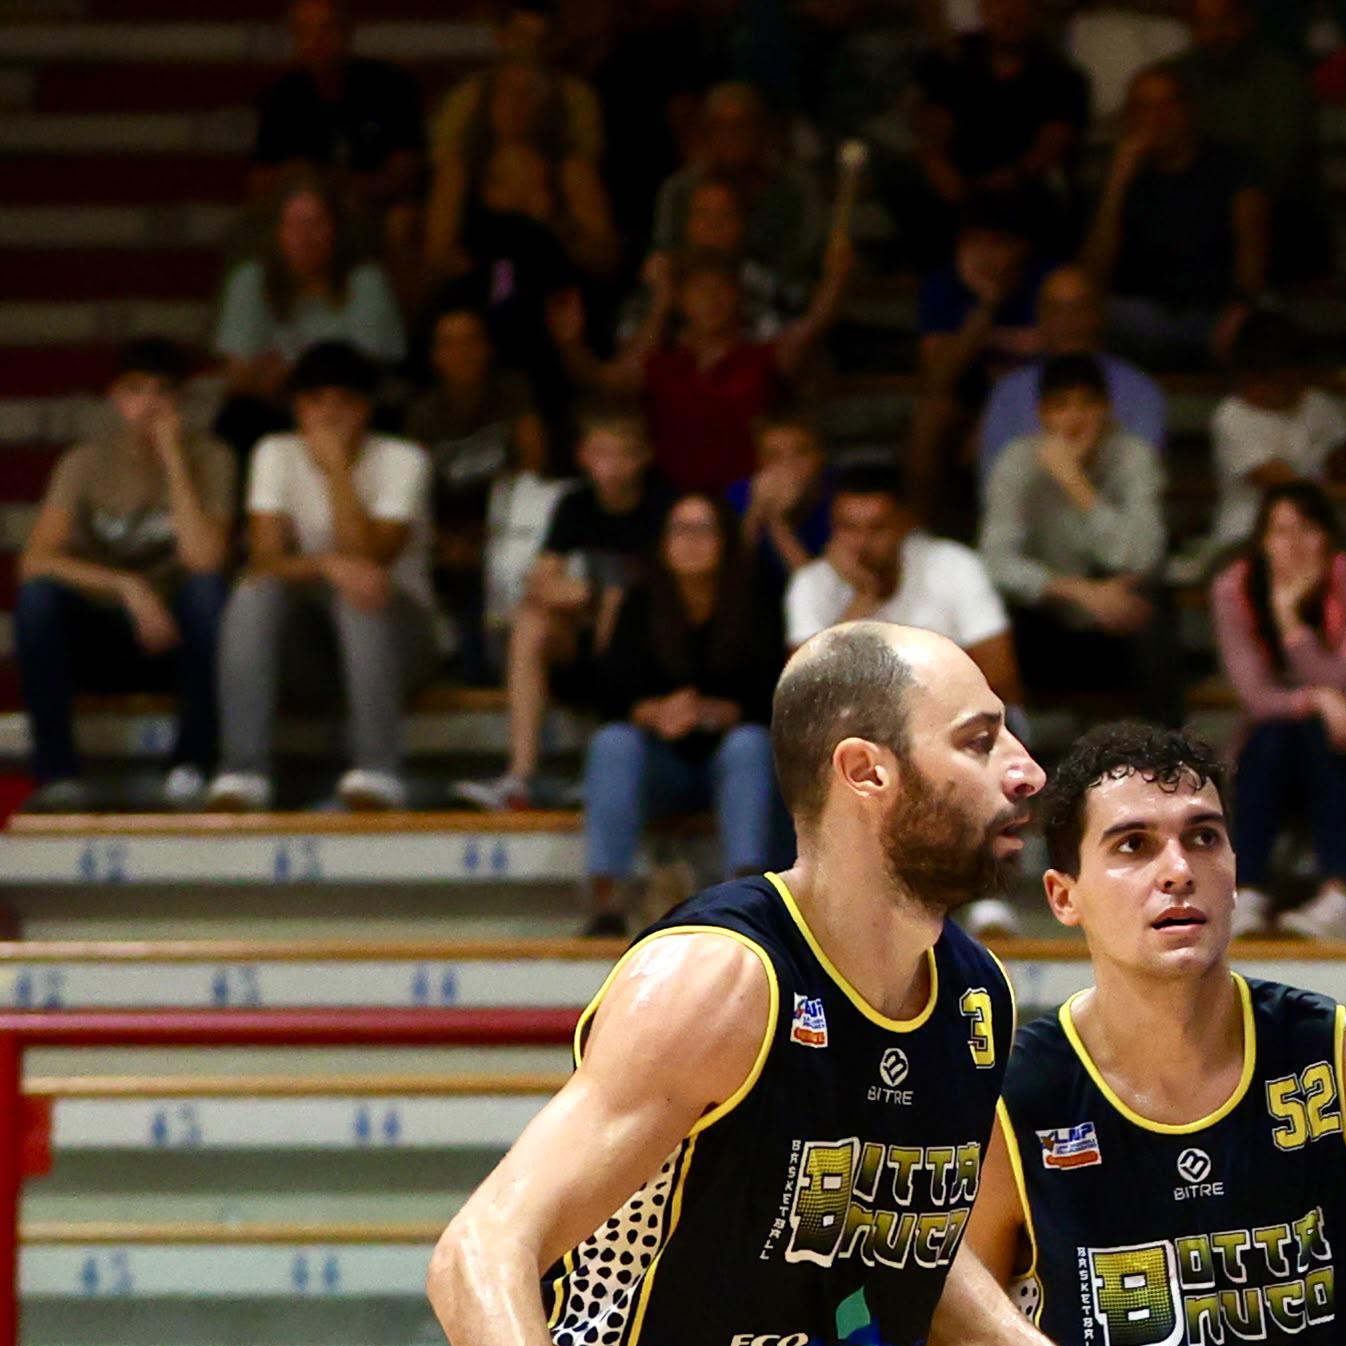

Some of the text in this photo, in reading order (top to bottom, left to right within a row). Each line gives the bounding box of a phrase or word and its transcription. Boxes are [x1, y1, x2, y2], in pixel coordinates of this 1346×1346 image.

[959, 987, 995, 1069] 3
[867, 1085, 914, 1106] BITRE
[1265, 1060, 1343, 1152] 52
[760, 1139, 801, 1260] BASKETBALL
[1173, 1181, 1225, 1201] BITRE
